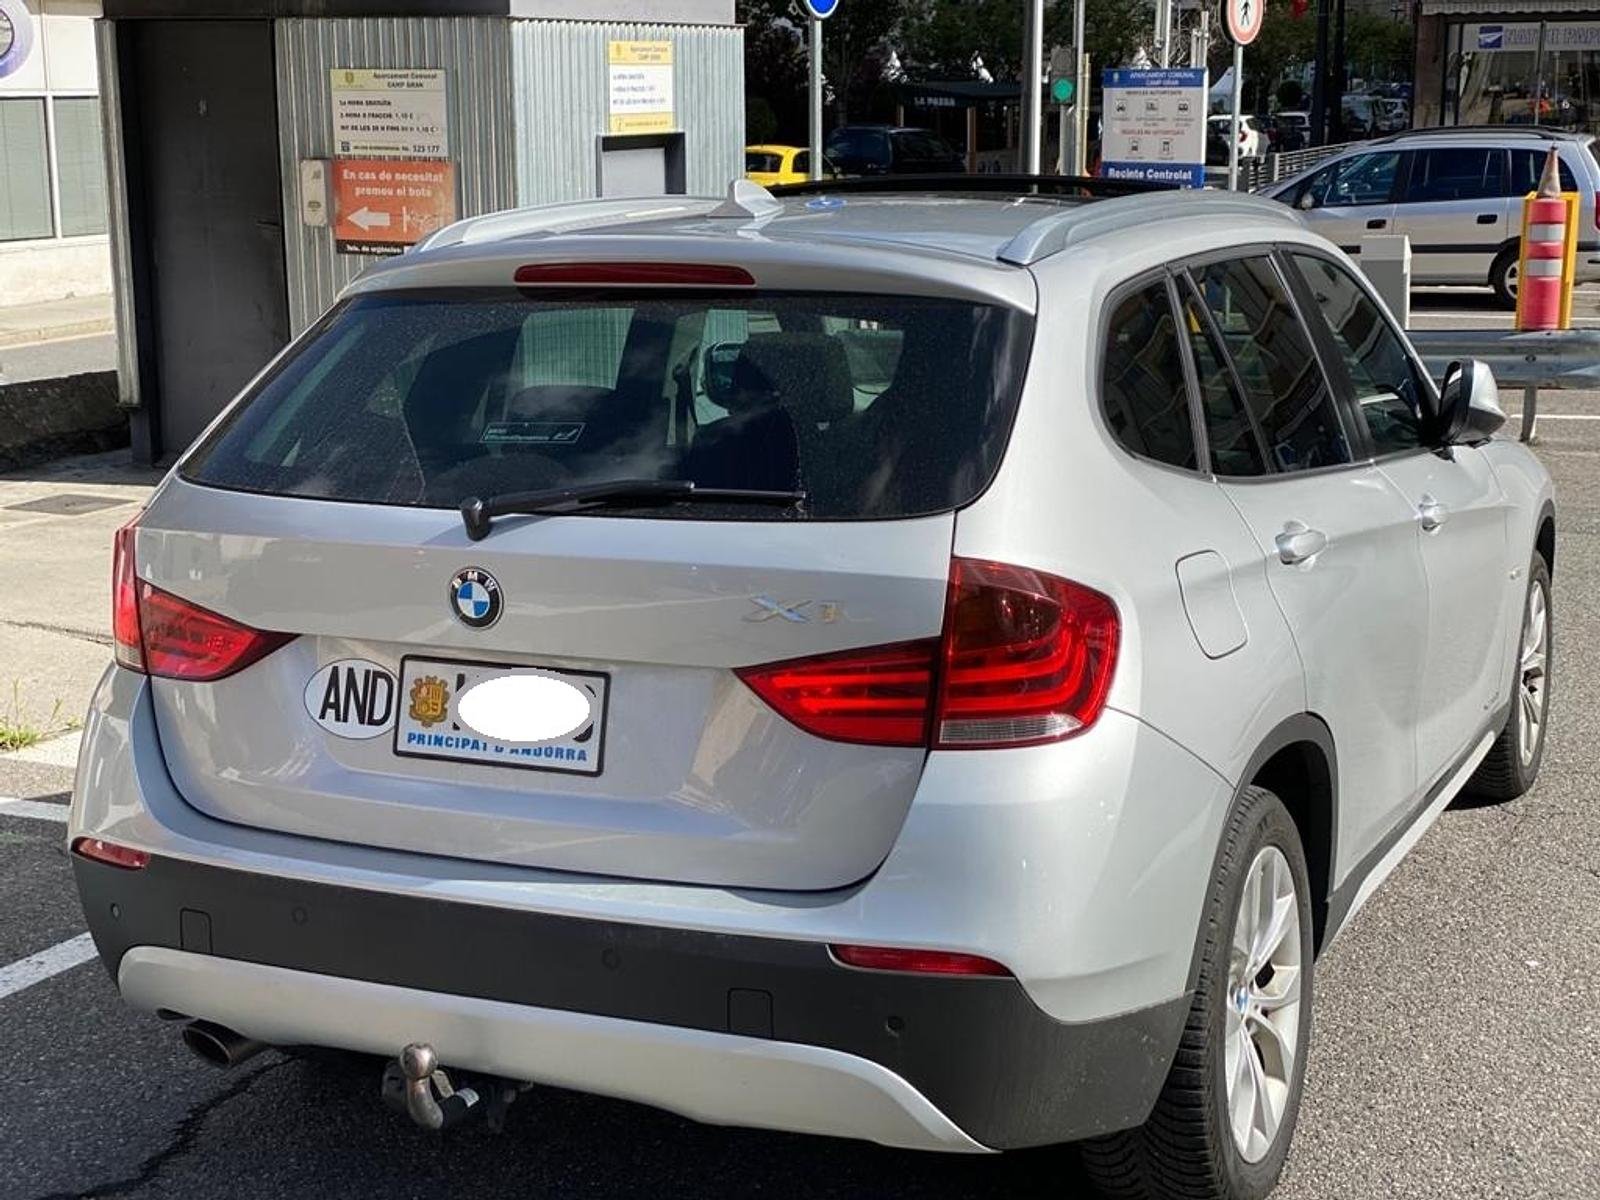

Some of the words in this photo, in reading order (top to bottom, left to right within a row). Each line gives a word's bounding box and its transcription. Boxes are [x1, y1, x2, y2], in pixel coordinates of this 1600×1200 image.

[343, 169, 356, 180] En
[358, 171, 376, 180] cas
[378, 170, 392, 180] de
[395, 171, 444, 182] necesitat
[1108, 168, 1145, 179] Recinte
[1146, 168, 1192, 180] Controlat
[354, 187, 394, 197] premou
[397, 186, 406, 196] el
[452, 570, 498, 592] BMW
[740, 591, 847, 625] X1
[319, 665, 395, 727] AND
